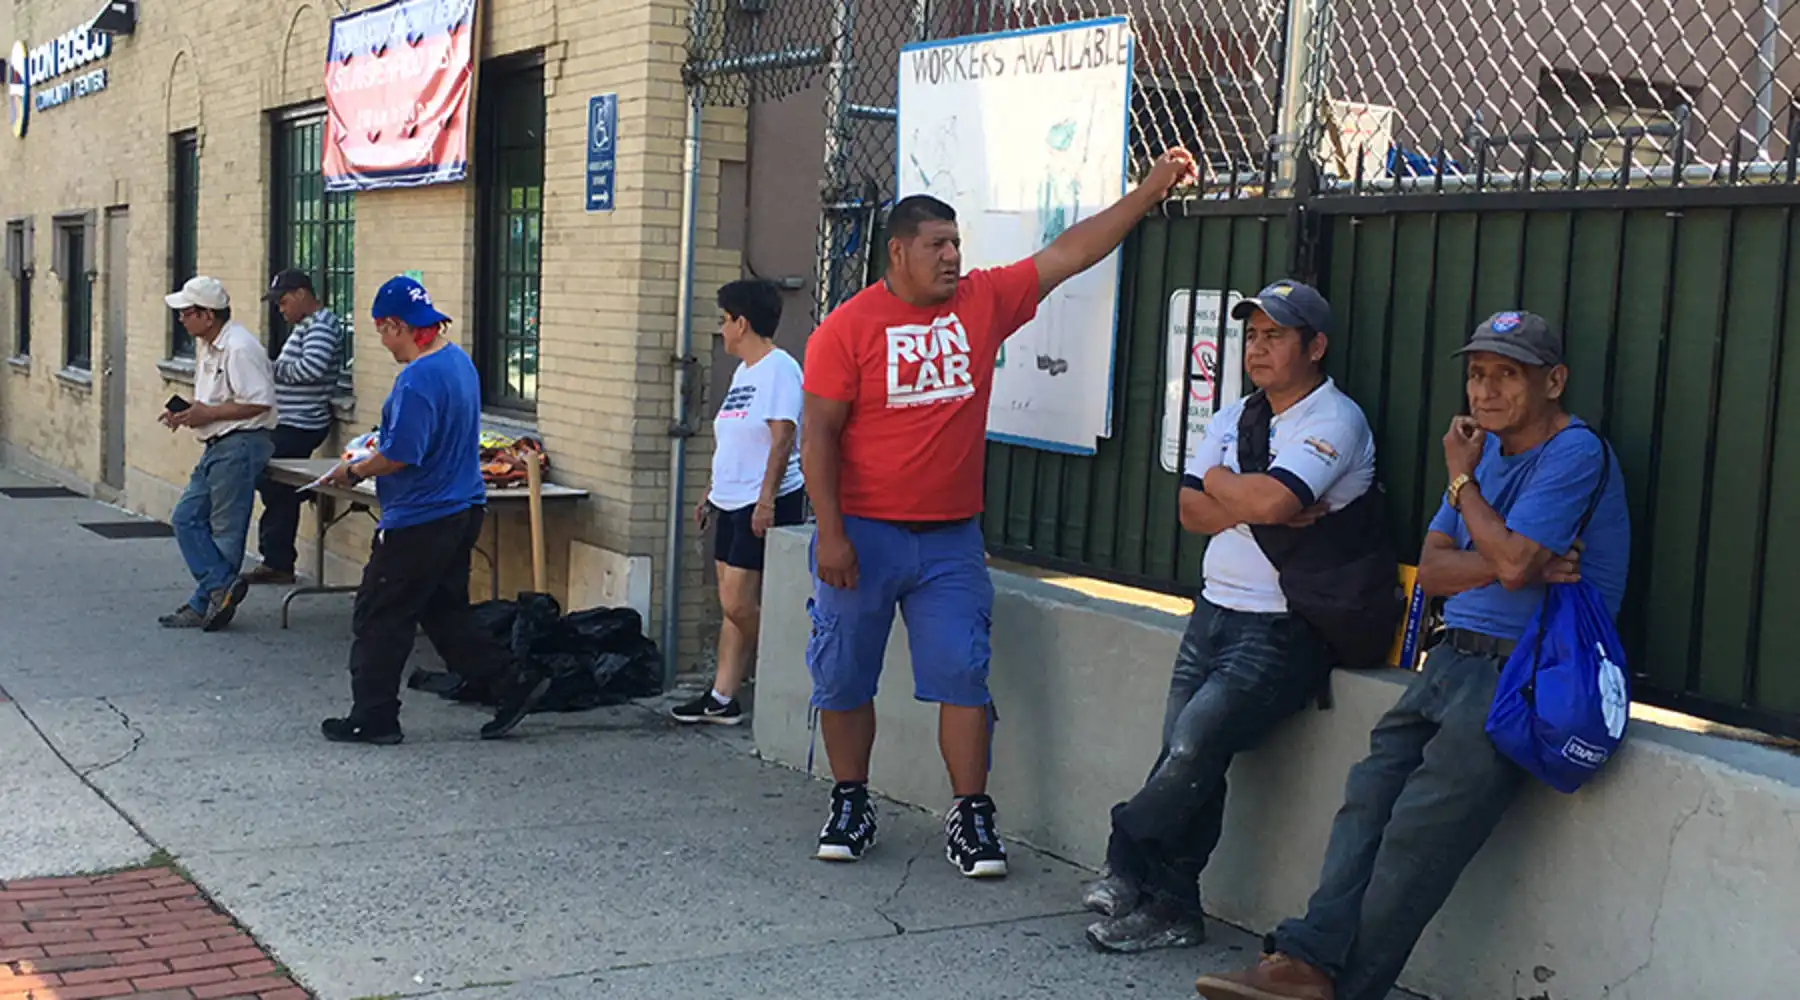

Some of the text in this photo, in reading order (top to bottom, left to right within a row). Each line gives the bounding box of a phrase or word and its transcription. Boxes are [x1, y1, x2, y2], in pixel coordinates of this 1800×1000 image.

[30, 24, 109, 85] DON BOSCO
[912, 25, 1128, 85] WORKERS AVAILABLE
[887, 320, 970, 363] RUN
[888, 355, 972, 394] LAR
